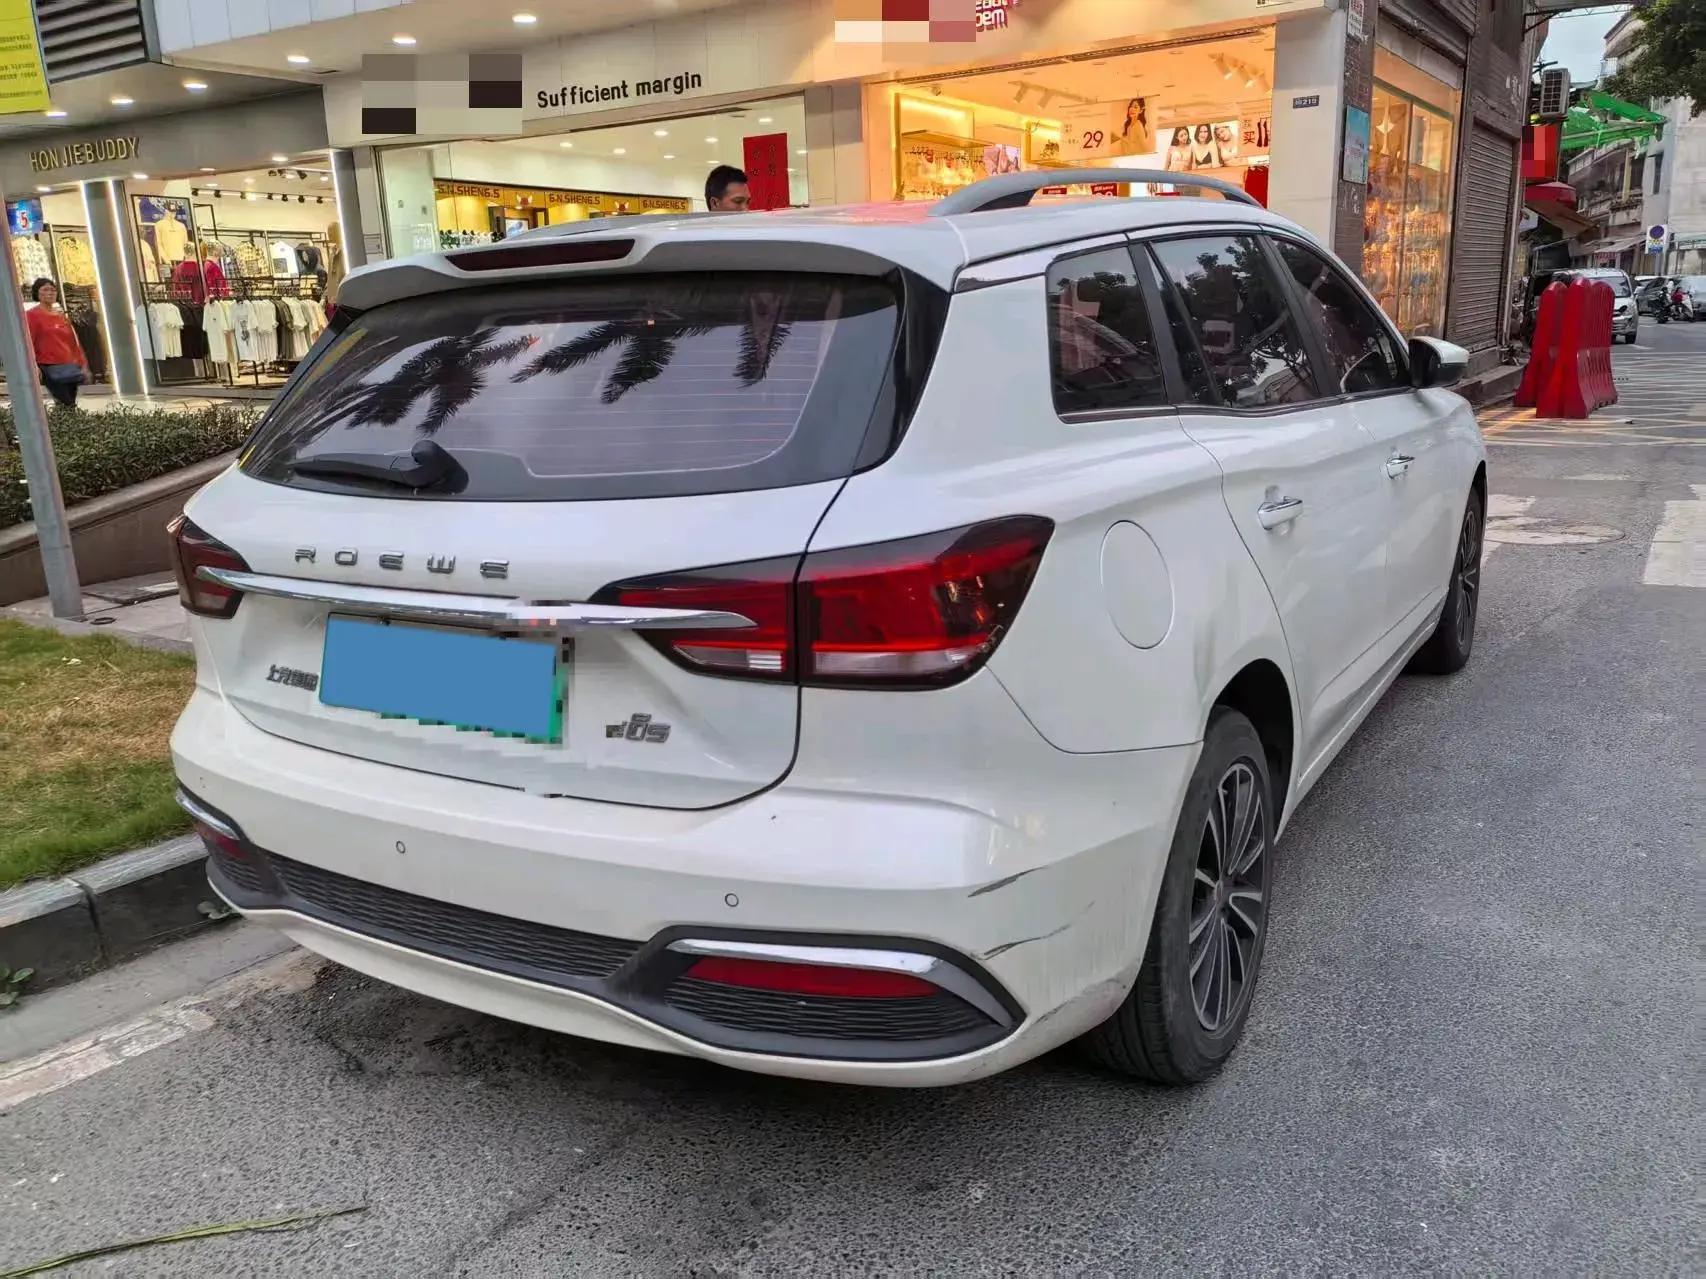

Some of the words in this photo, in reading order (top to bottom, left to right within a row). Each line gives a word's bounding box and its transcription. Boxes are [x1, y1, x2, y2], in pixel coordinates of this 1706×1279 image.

[537, 80, 628, 108] Sufficient
[635, 72, 702, 95] margin
[1082, 130, 1104, 149] 29
[294, 546, 510, 579] ROEWE
